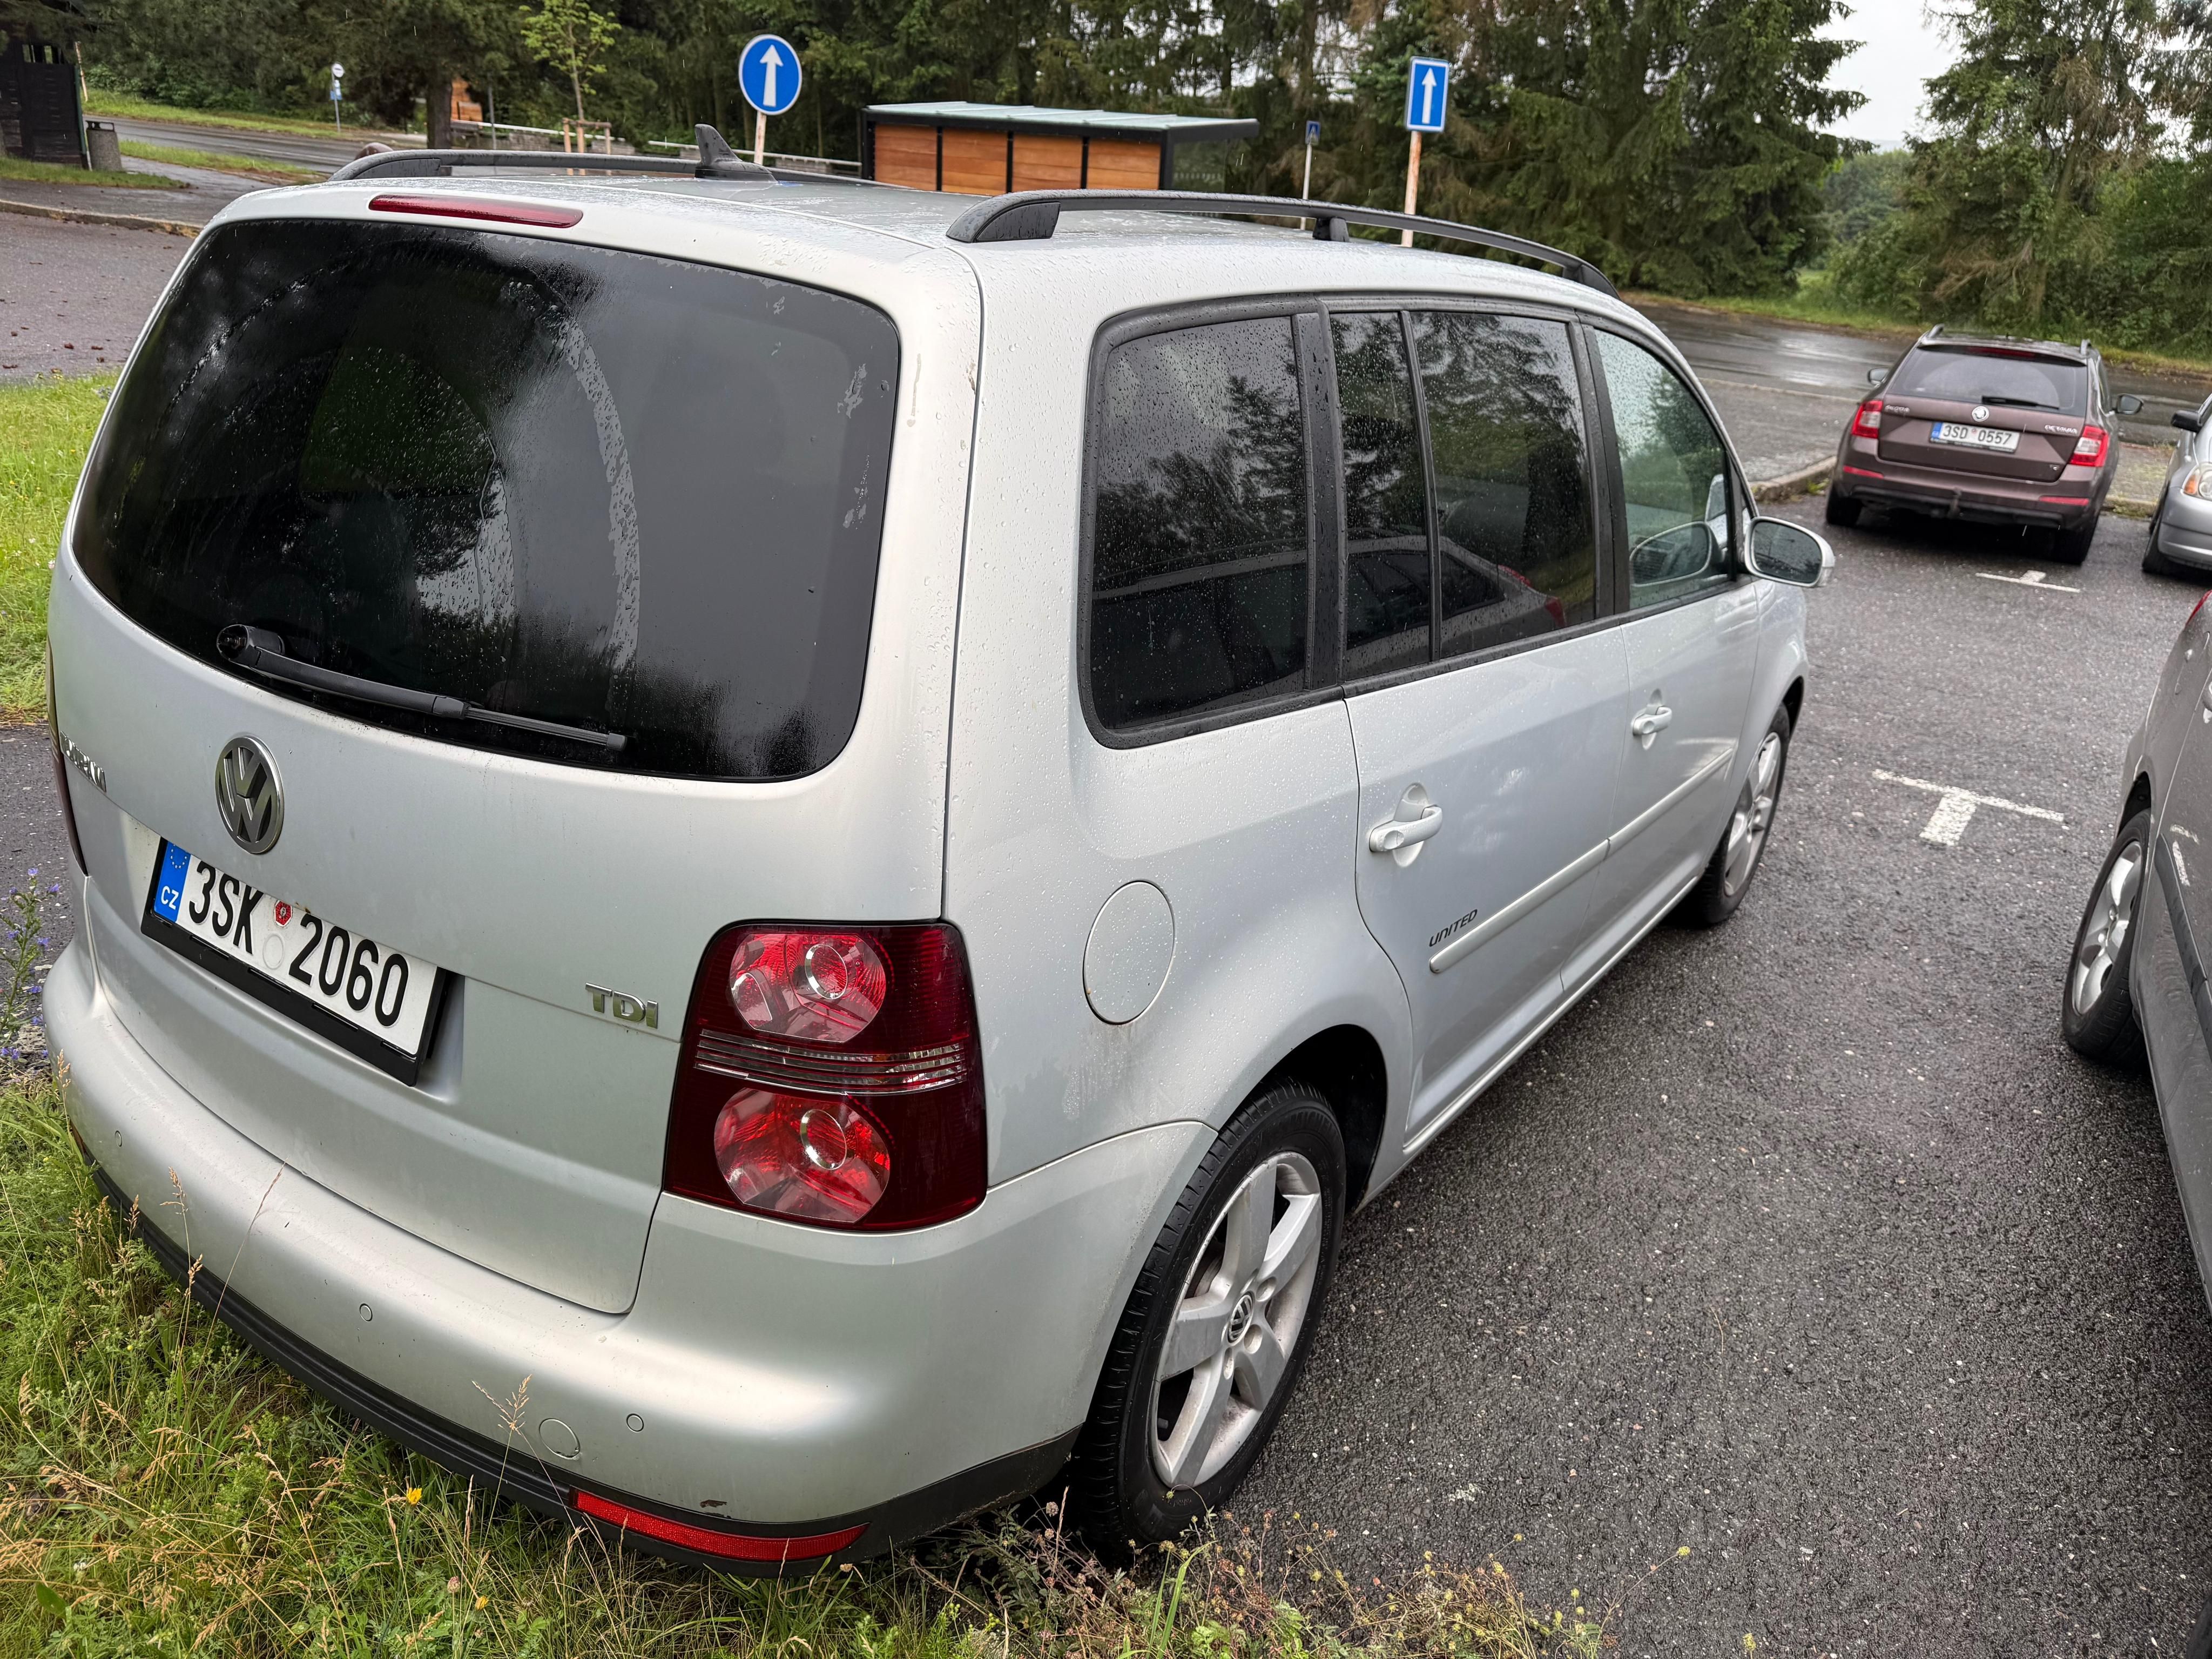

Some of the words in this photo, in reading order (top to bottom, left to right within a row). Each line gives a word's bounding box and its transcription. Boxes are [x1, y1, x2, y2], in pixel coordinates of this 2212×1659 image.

[1943, 424, 1968, 439] 3SD
[1978, 429, 2012, 445] 0557
[160, 885, 179, 910] CZ
[188, 860, 264, 955] 3SK
[288, 913, 409, 1027] 2060
[1429, 908, 1478, 947] UNITED
[585, 982, 658, 1029] TDI
